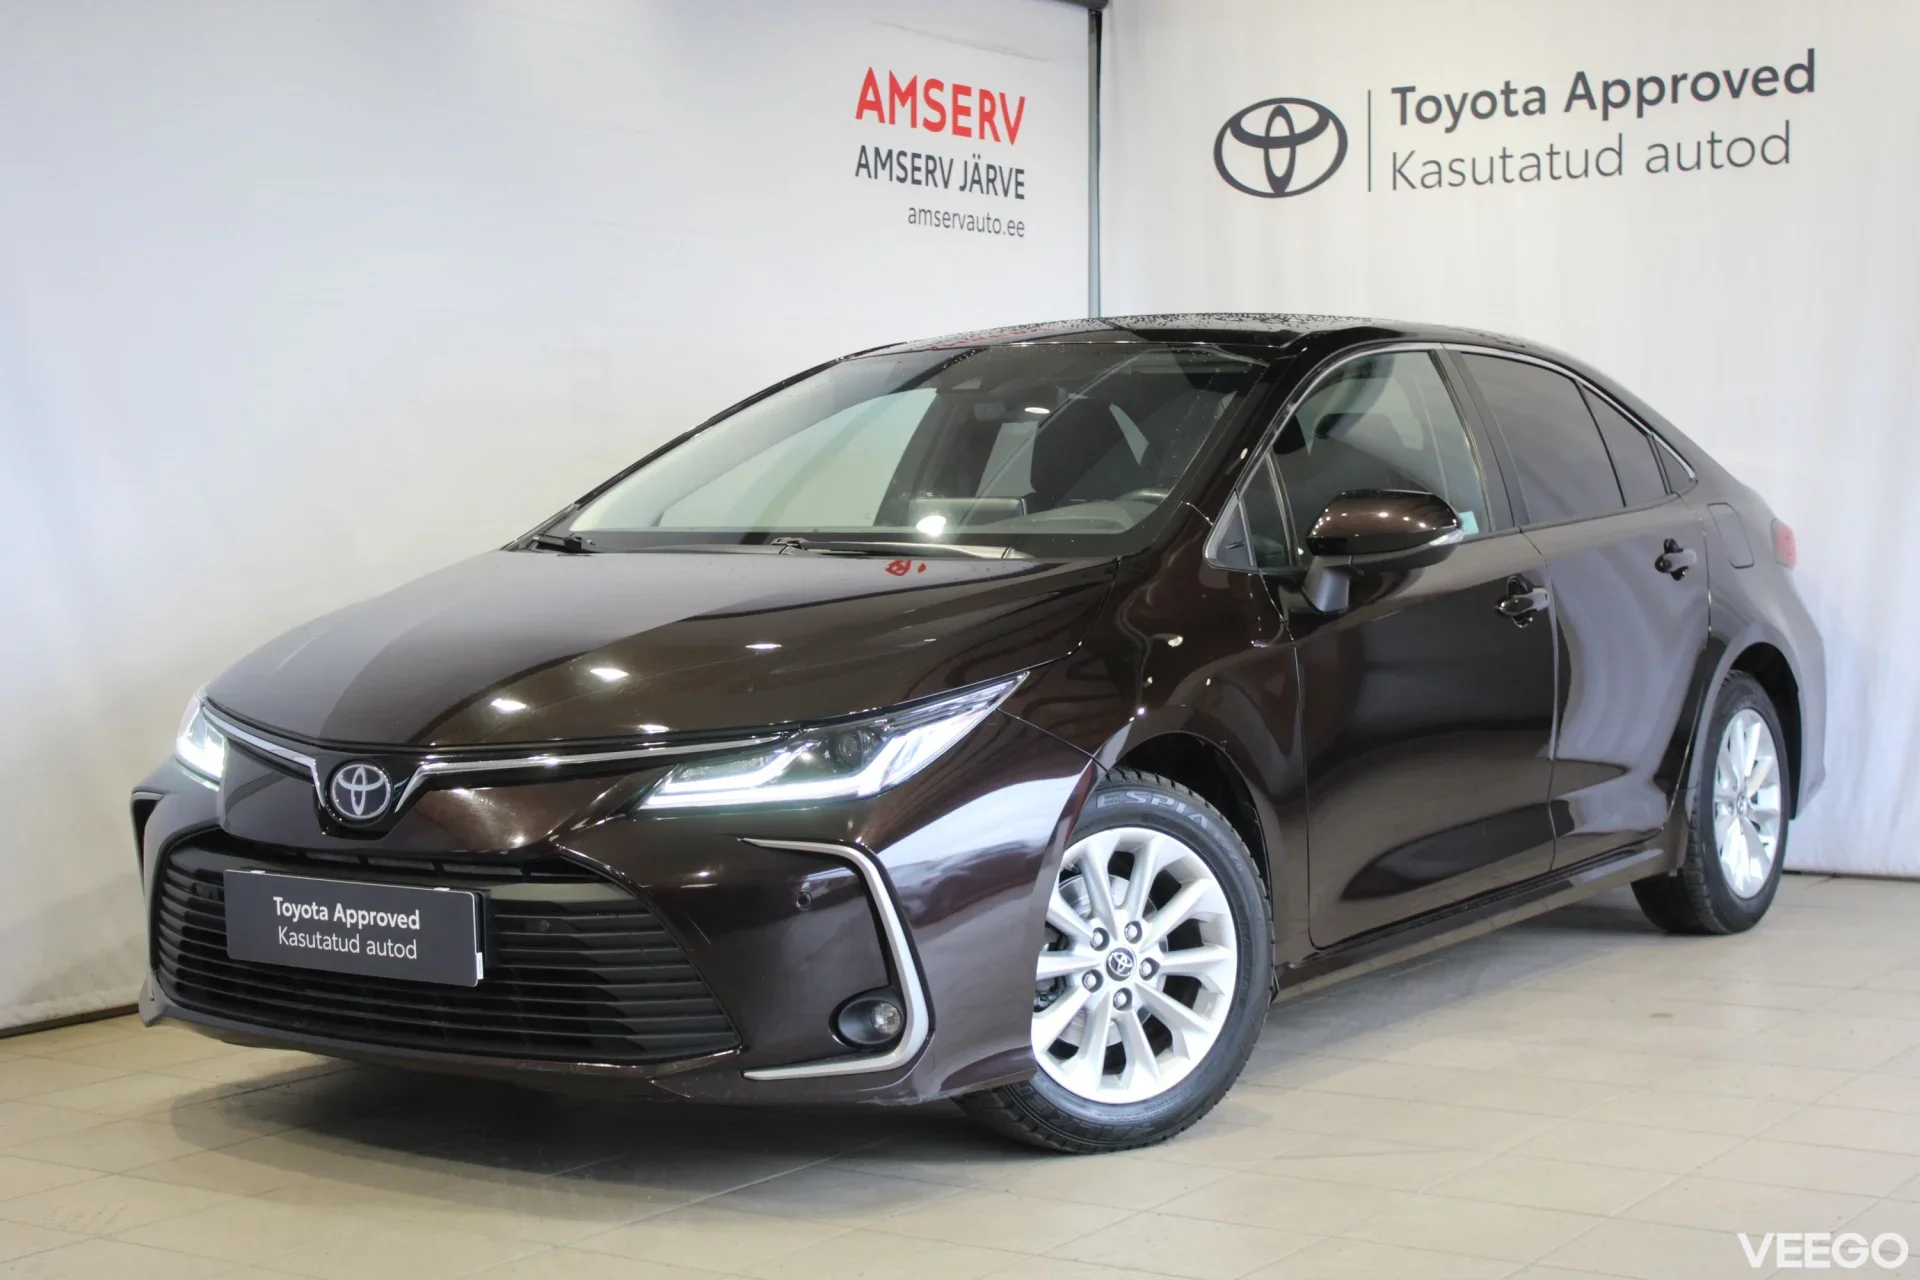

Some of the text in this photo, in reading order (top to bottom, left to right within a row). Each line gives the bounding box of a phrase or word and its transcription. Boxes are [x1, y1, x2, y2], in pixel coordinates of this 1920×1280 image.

[855, 65, 1026, 146] AMSERV
[1390, 47, 1817, 134] Toyota Approved
[854, 144, 1026, 200] AMSERV JÄRVE
[1391, 119, 1792, 192] Kasutatud autod
[907, 206, 1026, 238] amservauto.ee
[1096, 790, 1209, 830] ESPIA
[272, 896, 420, 930] Toyota Approved
[277, 925, 418, 960] Kasutatud autod
